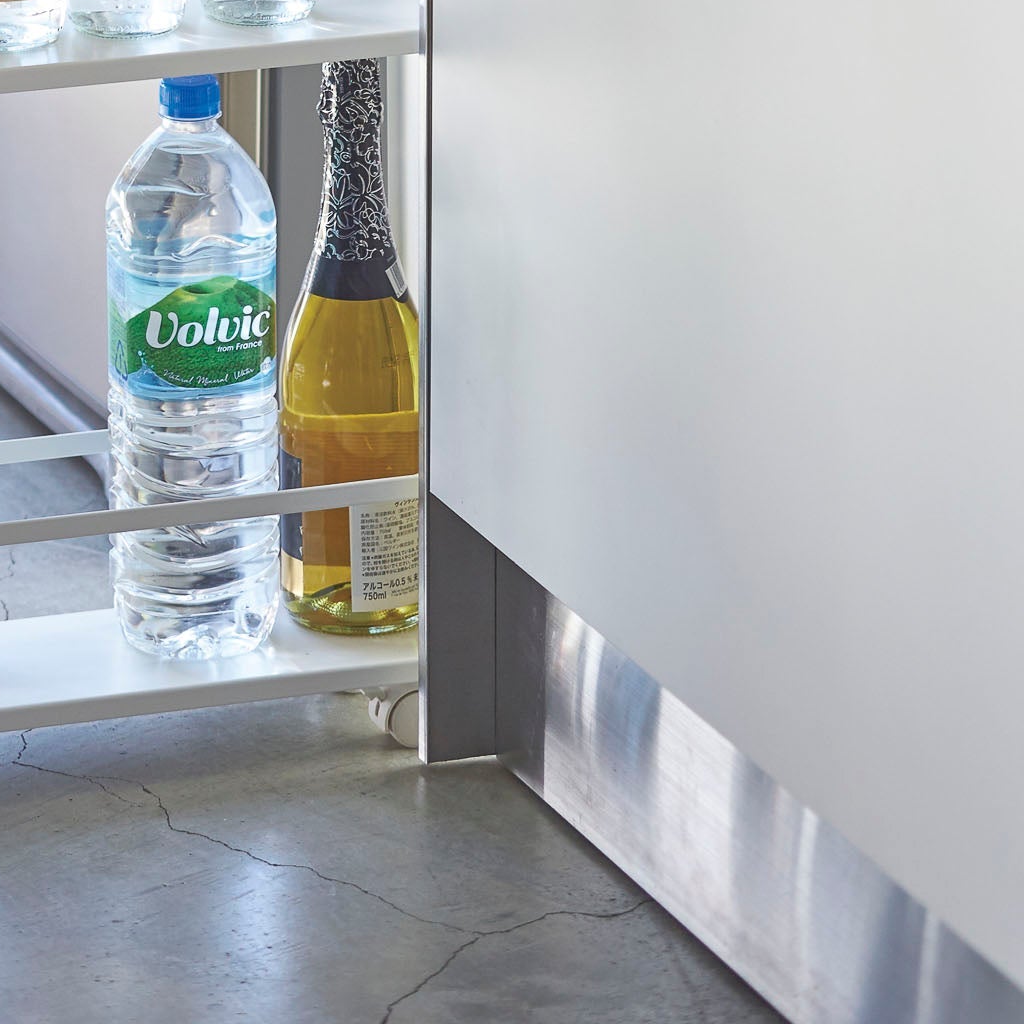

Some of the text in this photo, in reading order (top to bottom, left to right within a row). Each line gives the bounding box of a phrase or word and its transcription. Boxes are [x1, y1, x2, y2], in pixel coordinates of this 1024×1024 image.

[145, 305, 270, 349] Volvic
[217, 340, 263, 353] from France
[163, 367, 256, 385] Natural Mineral Water
[363, 591, 387, 601] 750ml
